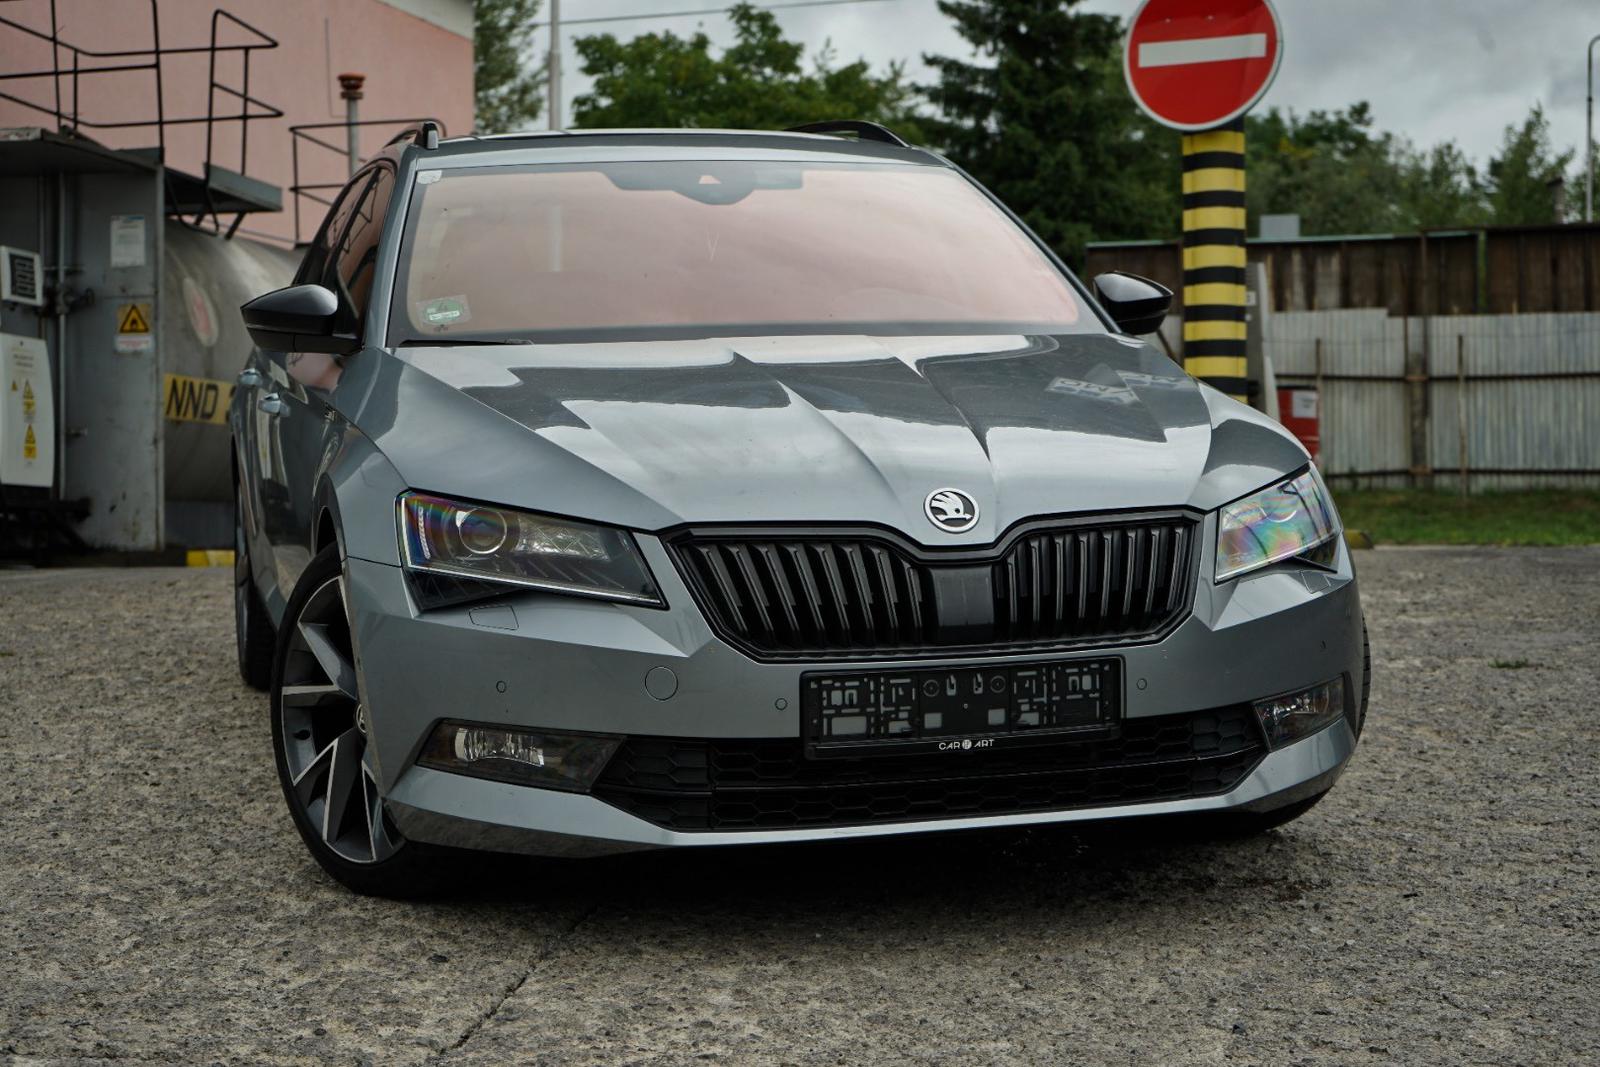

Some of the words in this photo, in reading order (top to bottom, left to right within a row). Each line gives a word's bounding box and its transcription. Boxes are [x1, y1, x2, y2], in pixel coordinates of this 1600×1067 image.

[166, 377, 219, 420] NND
[938, 741, 960, 750] CAR
[974, 739, 994, 748] ART
